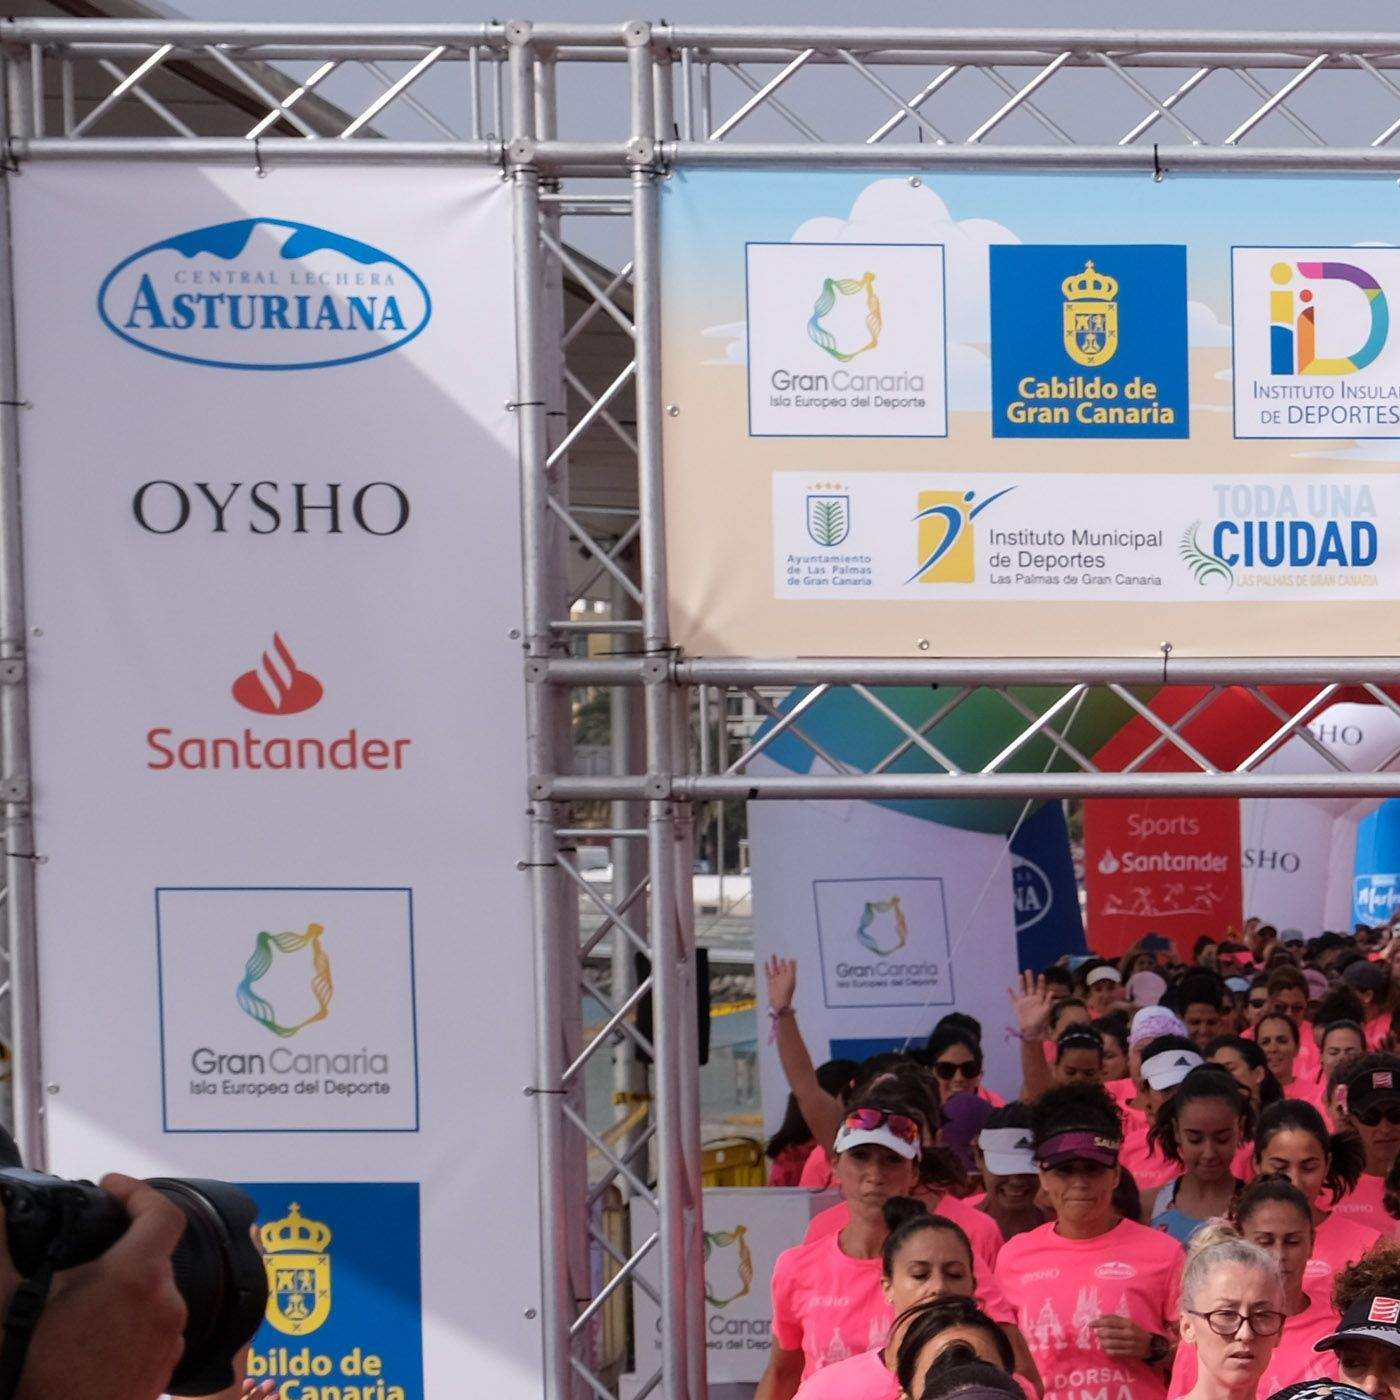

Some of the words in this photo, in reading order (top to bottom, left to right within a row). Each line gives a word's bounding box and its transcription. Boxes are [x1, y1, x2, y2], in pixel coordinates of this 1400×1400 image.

[174, 271, 280, 286] CENTRAL
[289, 272, 396, 288] LECHERA
[125, 272, 408, 332] ASTURIANA
[1018, 377, 1119, 399] Cabildo
[1124, 377, 1156, 399] de
[769, 396, 791, 407] Isla
[795, 396, 847, 409] Europea
[850, 396, 871, 407] del
[874, 396, 926, 409] Deporte
[1006, 401, 1069, 424] Gran
[1076, 402, 1174, 425] Canaria
[1287, 405, 1400, 425] DEPORTES
[132, 479, 411, 536] OYSHO
[1212, 484, 1299, 518] TODA
[1308, 484, 1377, 518] UNA
[989, 529, 1065, 547] Instituto
[1072, 529, 1162, 550] Municipal
[1212, 520, 1378, 568] CIUDAD
[787, 554, 871, 565] Ayuntamiento
[989, 552, 1011, 568] de
[1018, 551, 1105, 571] Deportes
[787, 566, 801, 575] de
[807, 566, 826, 575] Las
[832, 566, 872, 575] Palmas
[787, 576, 801, 586] de
[803, 576, 829, 586] Gran
[832, 577, 872, 586] Canaria
[990, 574, 1011, 585] Las
[1015, 574, 1060, 585] Palmas
[1063, 574, 1078, 585] de
[1082, 574, 1112, 585] Gran
[1115, 575, 1162, 586] Canaria
[146, 727, 412, 772] Santander
[1127, 814, 1199, 838] Sports
[1122, 851, 1229, 872] Santander
[1242, 850, 1301, 873] SHO
[189, 1080, 217, 1095] Isla
[222, 1080, 288, 1098] Europea
[294, 1080, 319, 1095] del
[324, 1080, 391, 1098] Deporte
[246, 1347, 332, 1377] bildo
[339, 1347, 382, 1377] de
[1053, 1366, 1136, 1391] DORSAL
